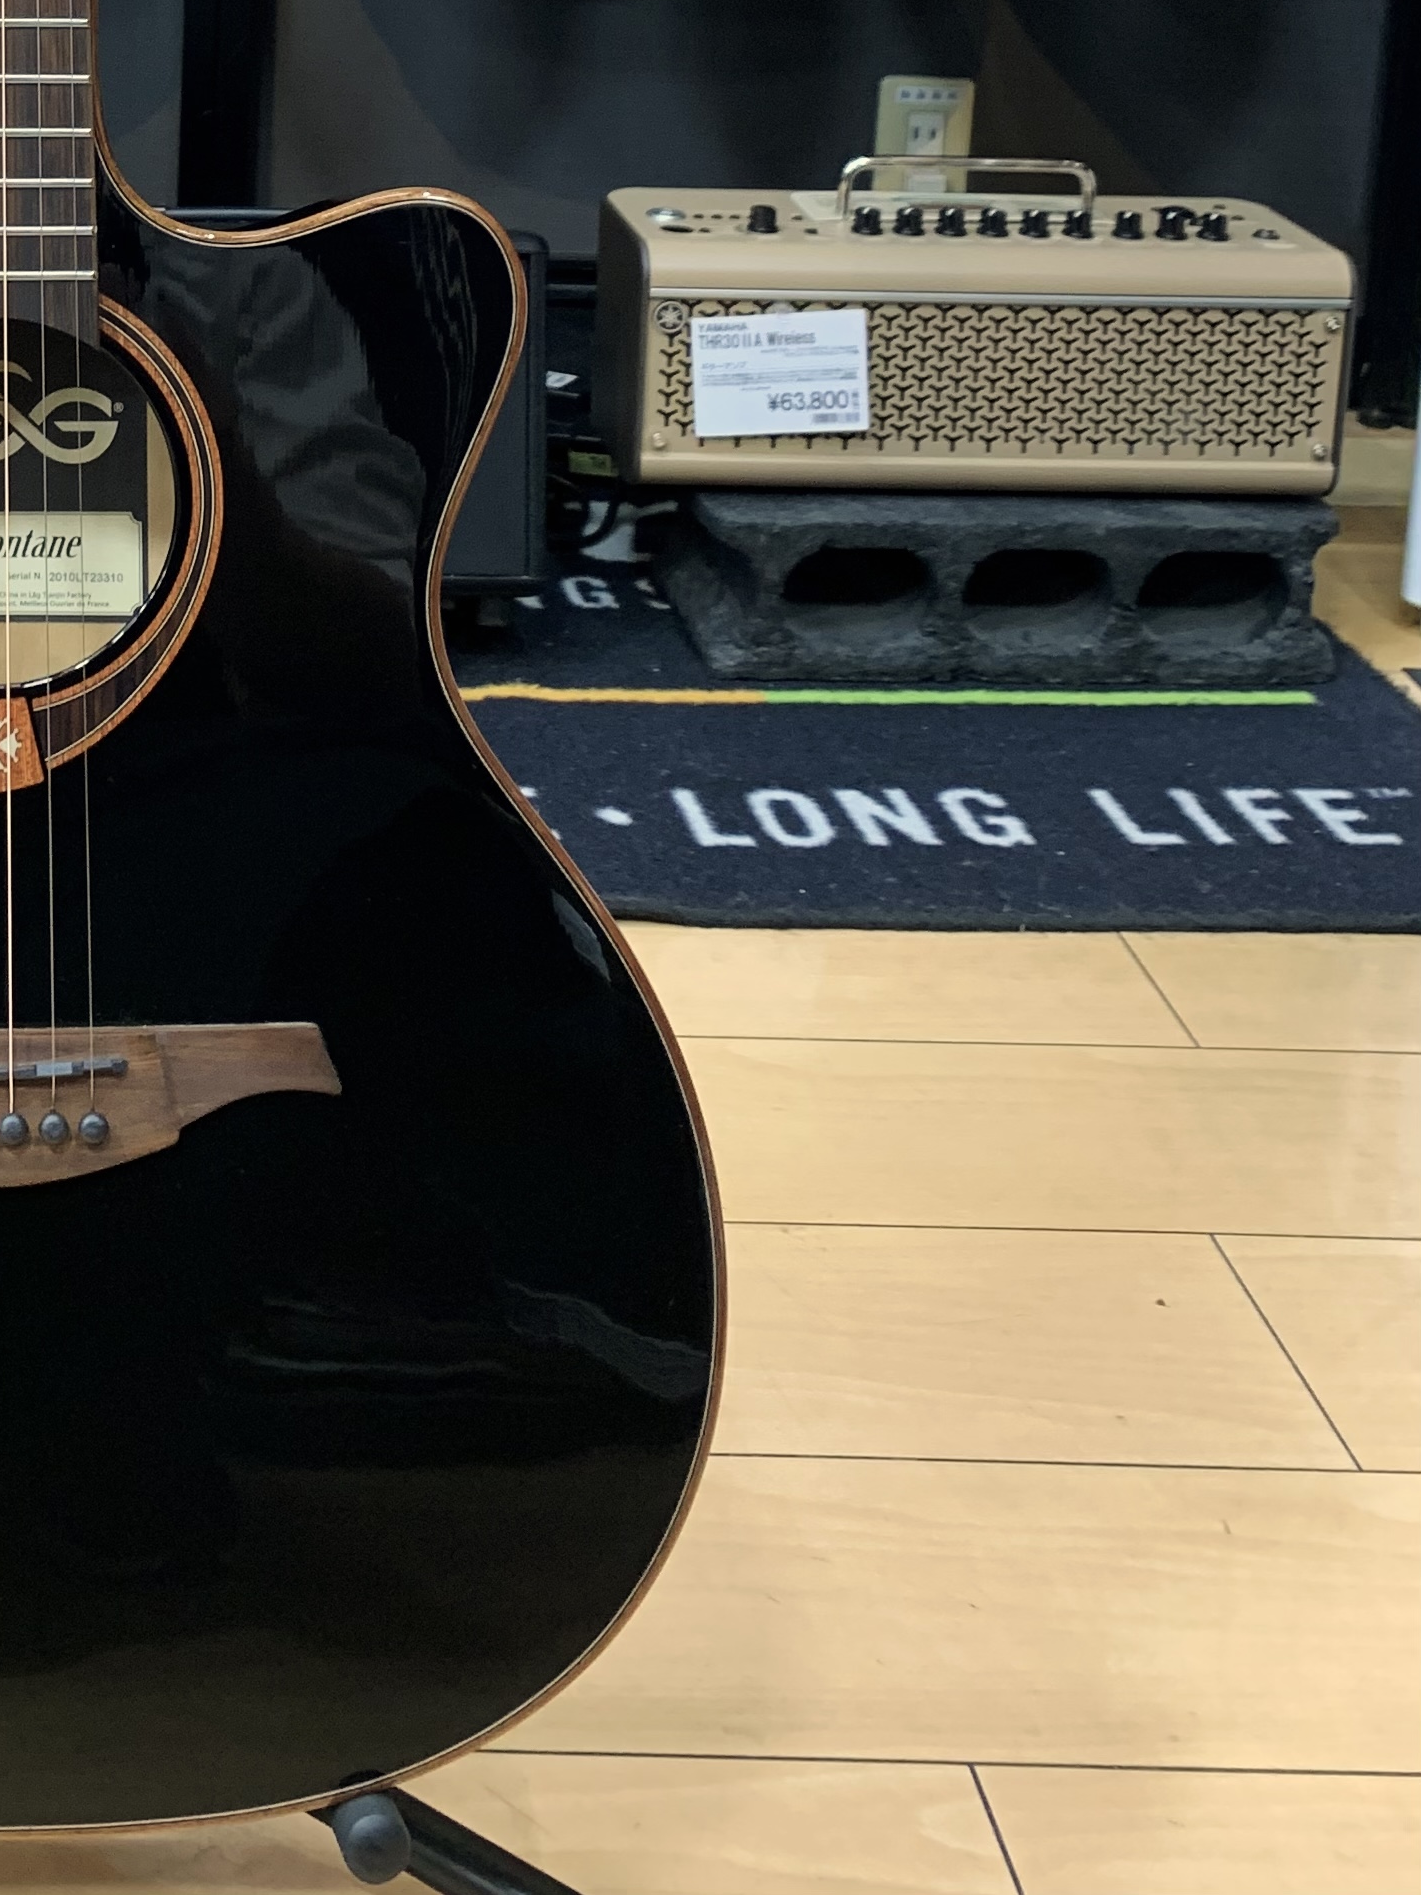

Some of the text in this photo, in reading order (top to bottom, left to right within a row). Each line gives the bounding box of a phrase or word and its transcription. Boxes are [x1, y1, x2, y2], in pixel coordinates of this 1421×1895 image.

[767, 330, 816, 346] Wireless
[767, 389, 850, 412] ¥63,800
[671, 786, 1036, 846] LONG
